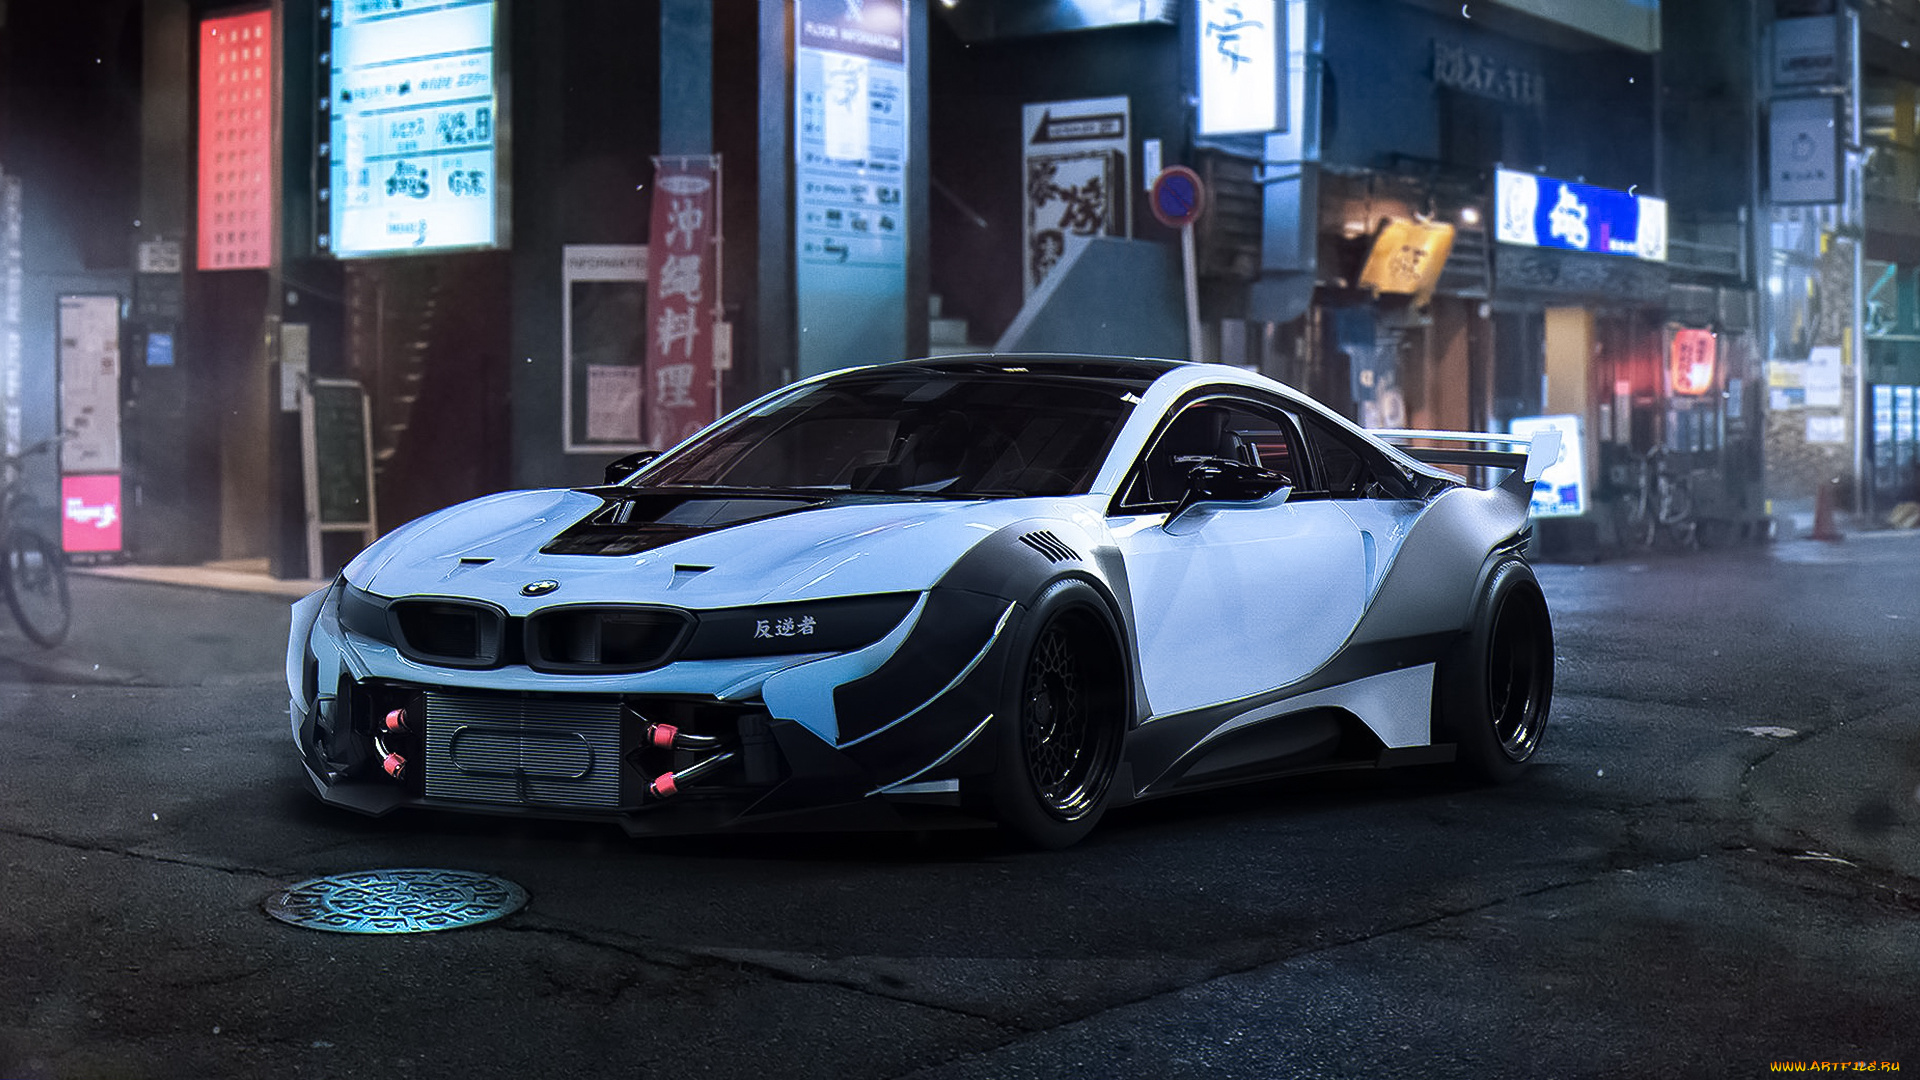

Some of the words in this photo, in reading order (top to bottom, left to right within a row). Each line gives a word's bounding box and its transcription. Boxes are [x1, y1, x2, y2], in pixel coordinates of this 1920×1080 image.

[803, 21, 839, 38] FLOOR
[569, 256, 648, 269] INFORMATIO
[656, 198, 703, 407] 沖縄料理
[753, 615, 817, 639] 反逆者
